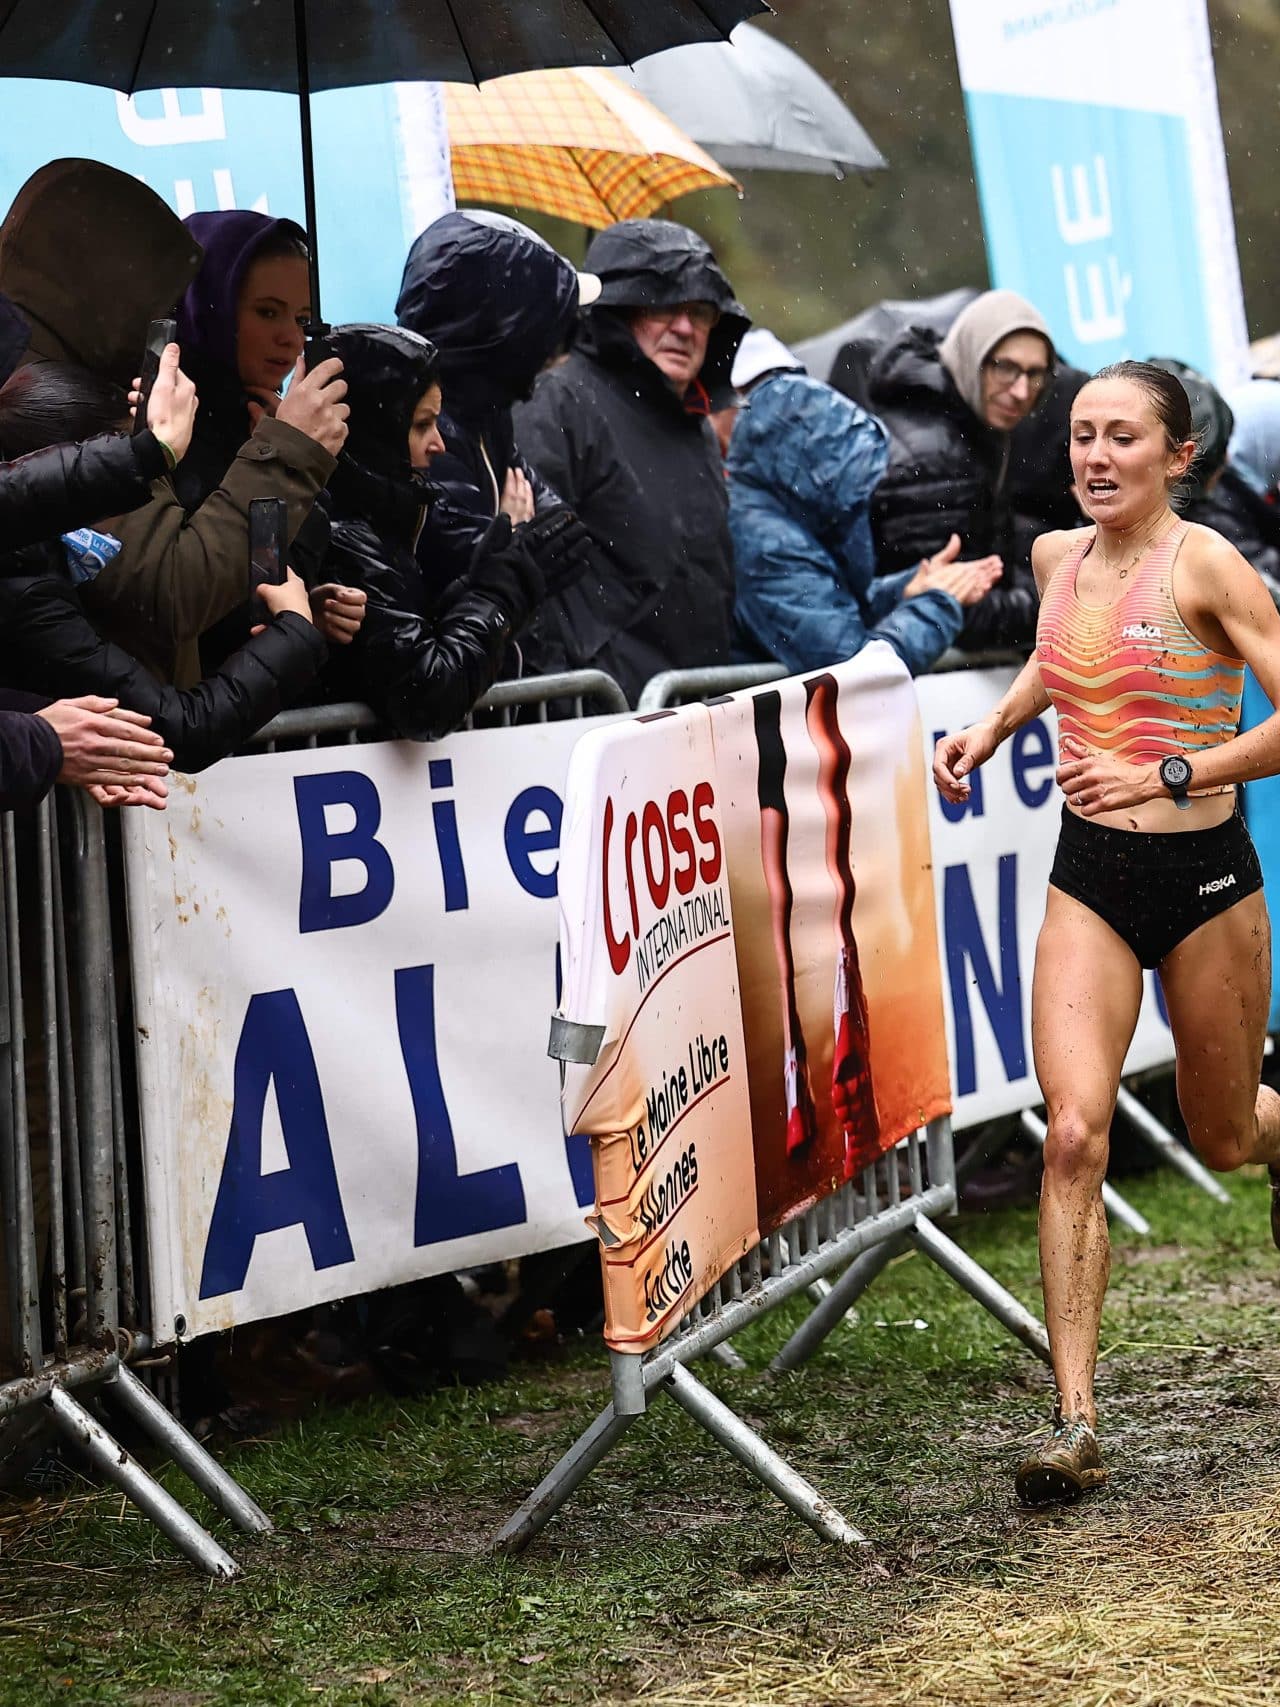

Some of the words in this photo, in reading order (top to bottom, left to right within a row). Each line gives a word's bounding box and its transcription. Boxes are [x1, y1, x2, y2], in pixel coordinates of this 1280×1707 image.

[1122, 624, 1162, 638] HOKA
[603, 782, 722, 975] Cross
[1199, 873, 1236, 896] HOKA
[635, 887, 729, 993] INTERNATIONAL
[627, 1127, 648, 1176] Le
[646, 1065, 688, 1149] Maine
[688, 1034, 729, 1091] Libre
[644, 1240, 692, 1322] Sarthe
